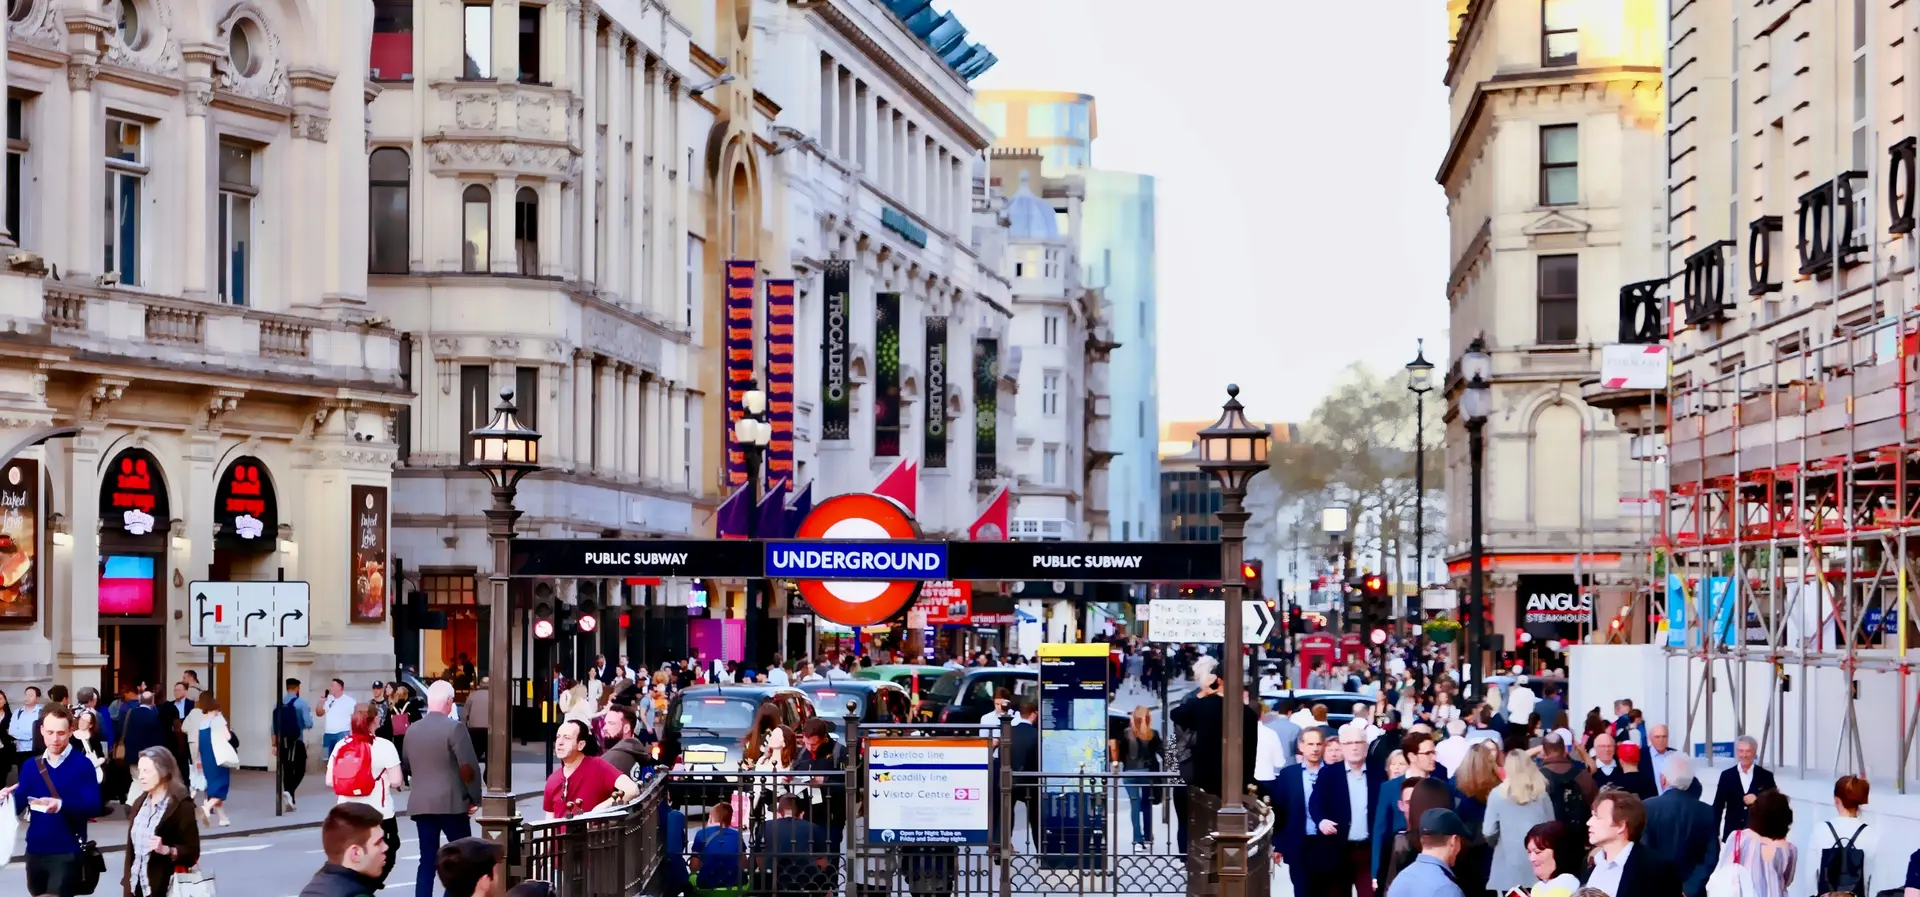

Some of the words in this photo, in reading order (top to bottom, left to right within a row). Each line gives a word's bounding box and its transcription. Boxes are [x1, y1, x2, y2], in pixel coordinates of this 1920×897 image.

[829, 293, 844, 401] TROCADERO
[929, 344, 943, 436] TROCADERO
[585, 552, 631, 565] PUBLIC
[634, 552, 688, 565] SUBWAY
[773, 550, 941, 571] UNDERGROUND
[1033, 555, 1082, 568] PUBLIC
[1084, 555, 1143, 568] SUBWAY
[1154, 603, 1172, 612] The
[1526, 592, 1592, 611] ANGUS
[883, 750, 924, 759] Bakerloo
[927, 750, 945, 759] line
[887, 773, 927, 783] ccadilly
[930, 773, 948, 781] line
[883, 790, 914, 798] Visitor
[917, 790, 951, 798] Centre
[899, 830, 915, 838] Open
[924, 830, 940, 838] Night
